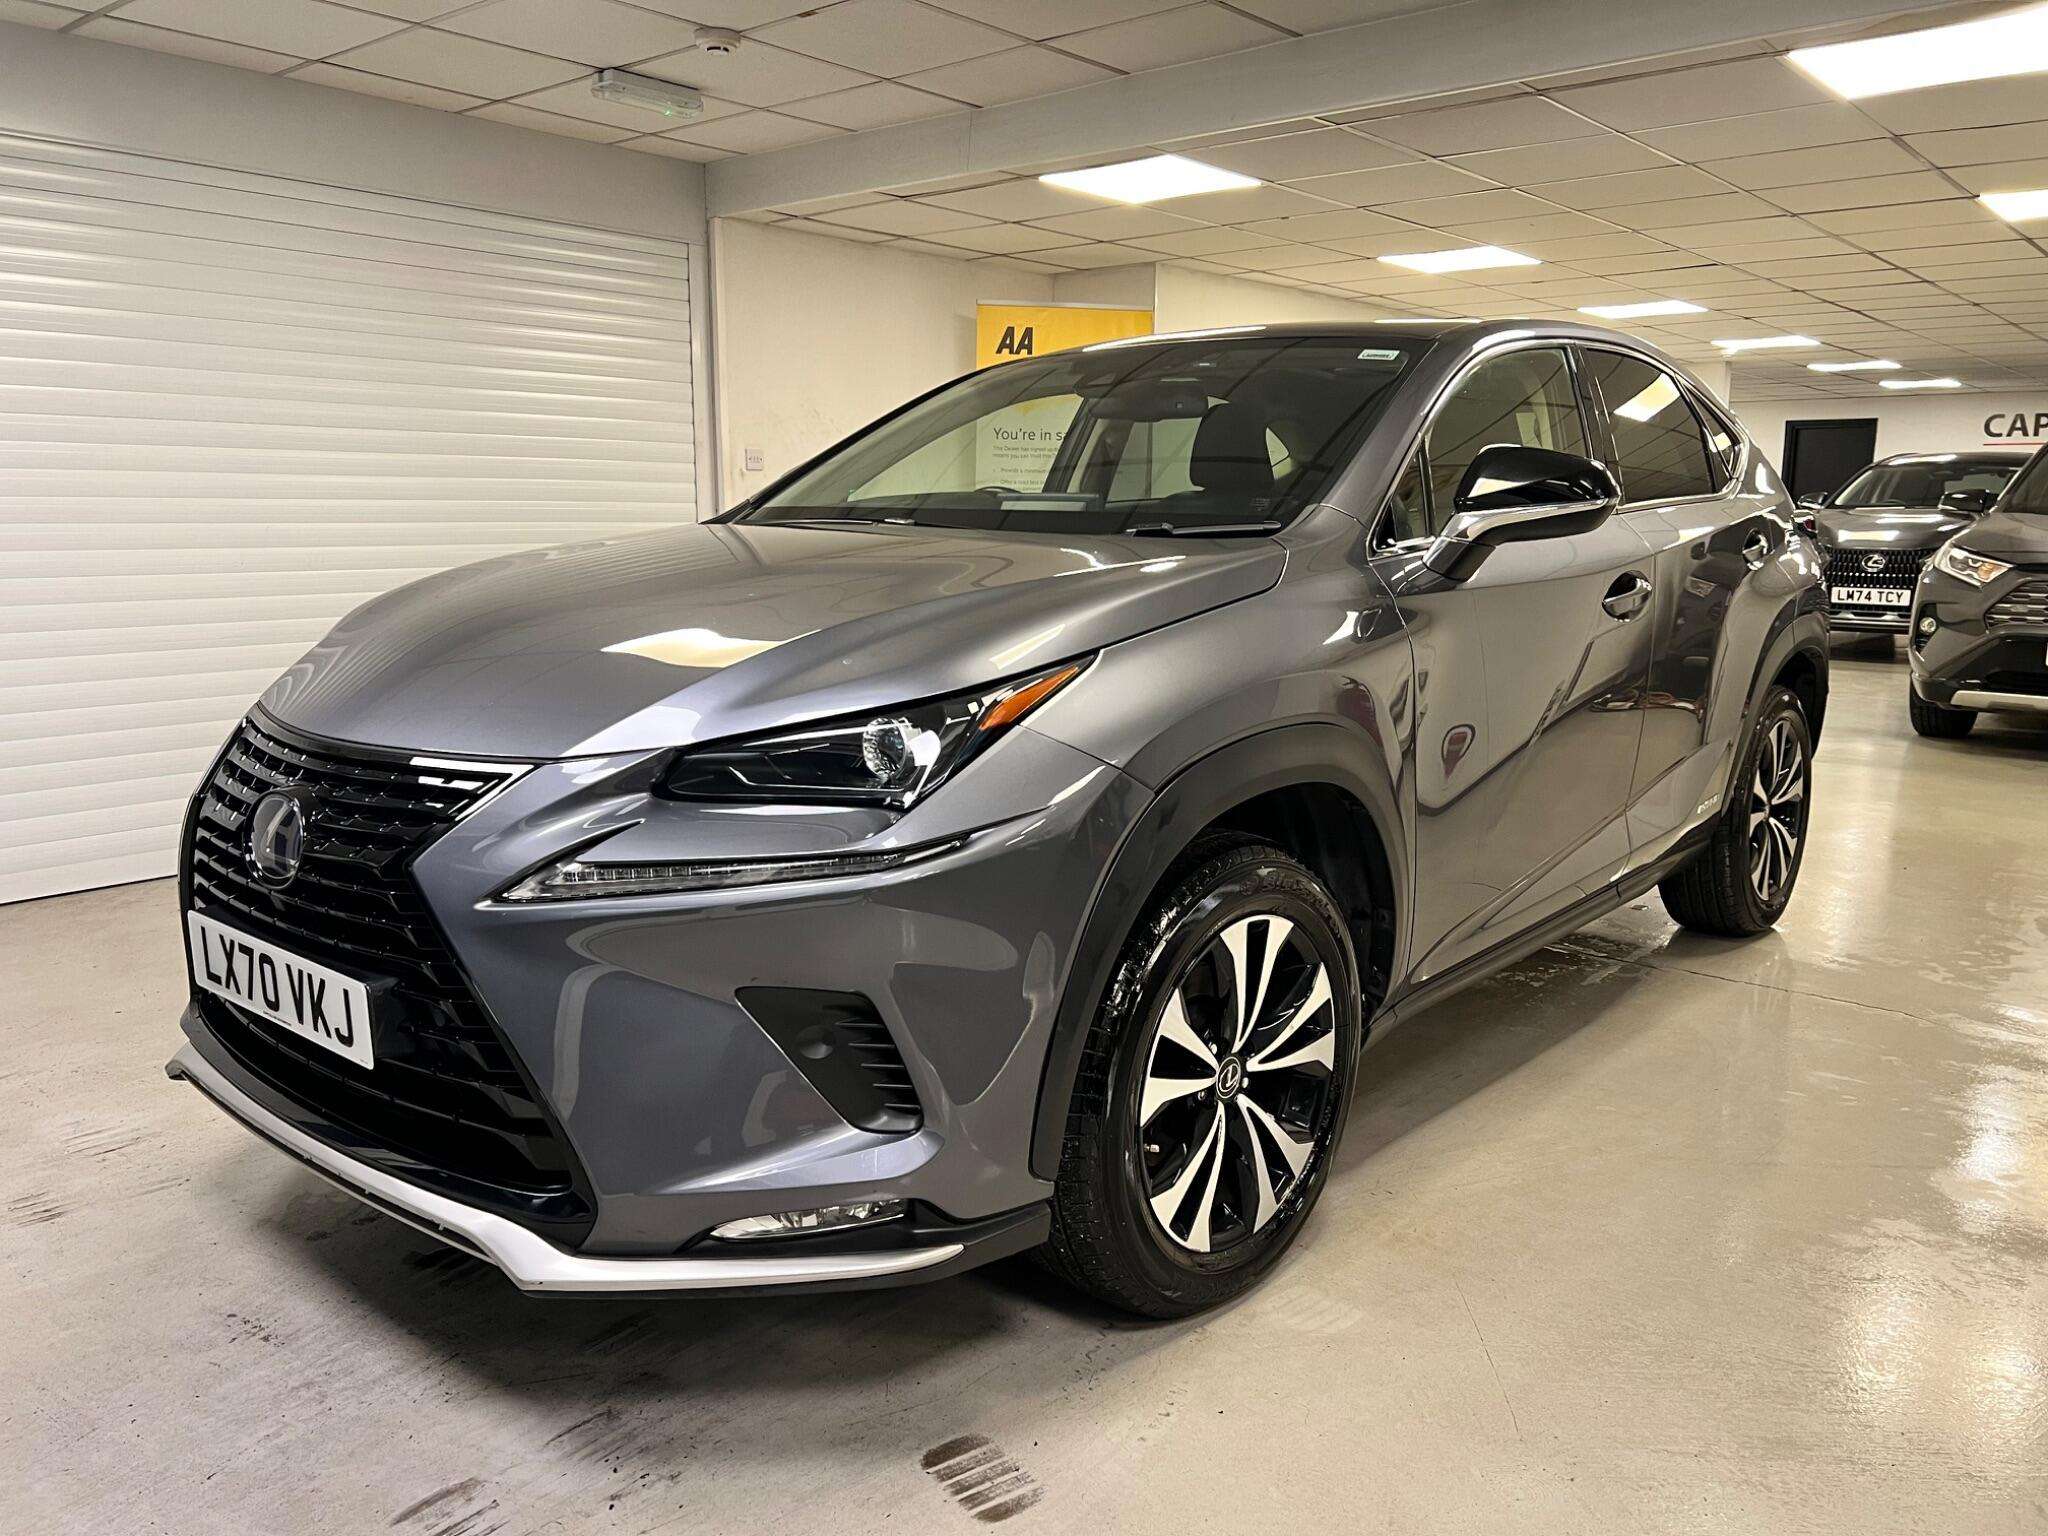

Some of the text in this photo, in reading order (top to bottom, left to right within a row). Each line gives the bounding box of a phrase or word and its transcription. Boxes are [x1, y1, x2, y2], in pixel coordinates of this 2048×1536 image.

[995, 326, 1034, 355] AA
[993, 428, 1067, 441] You're in s
[1983, 413, 2048, 437] CAP
[1837, 589, 1904, 604] LM74 TCY
[200, 925, 354, 1048] LX70 VKJ
